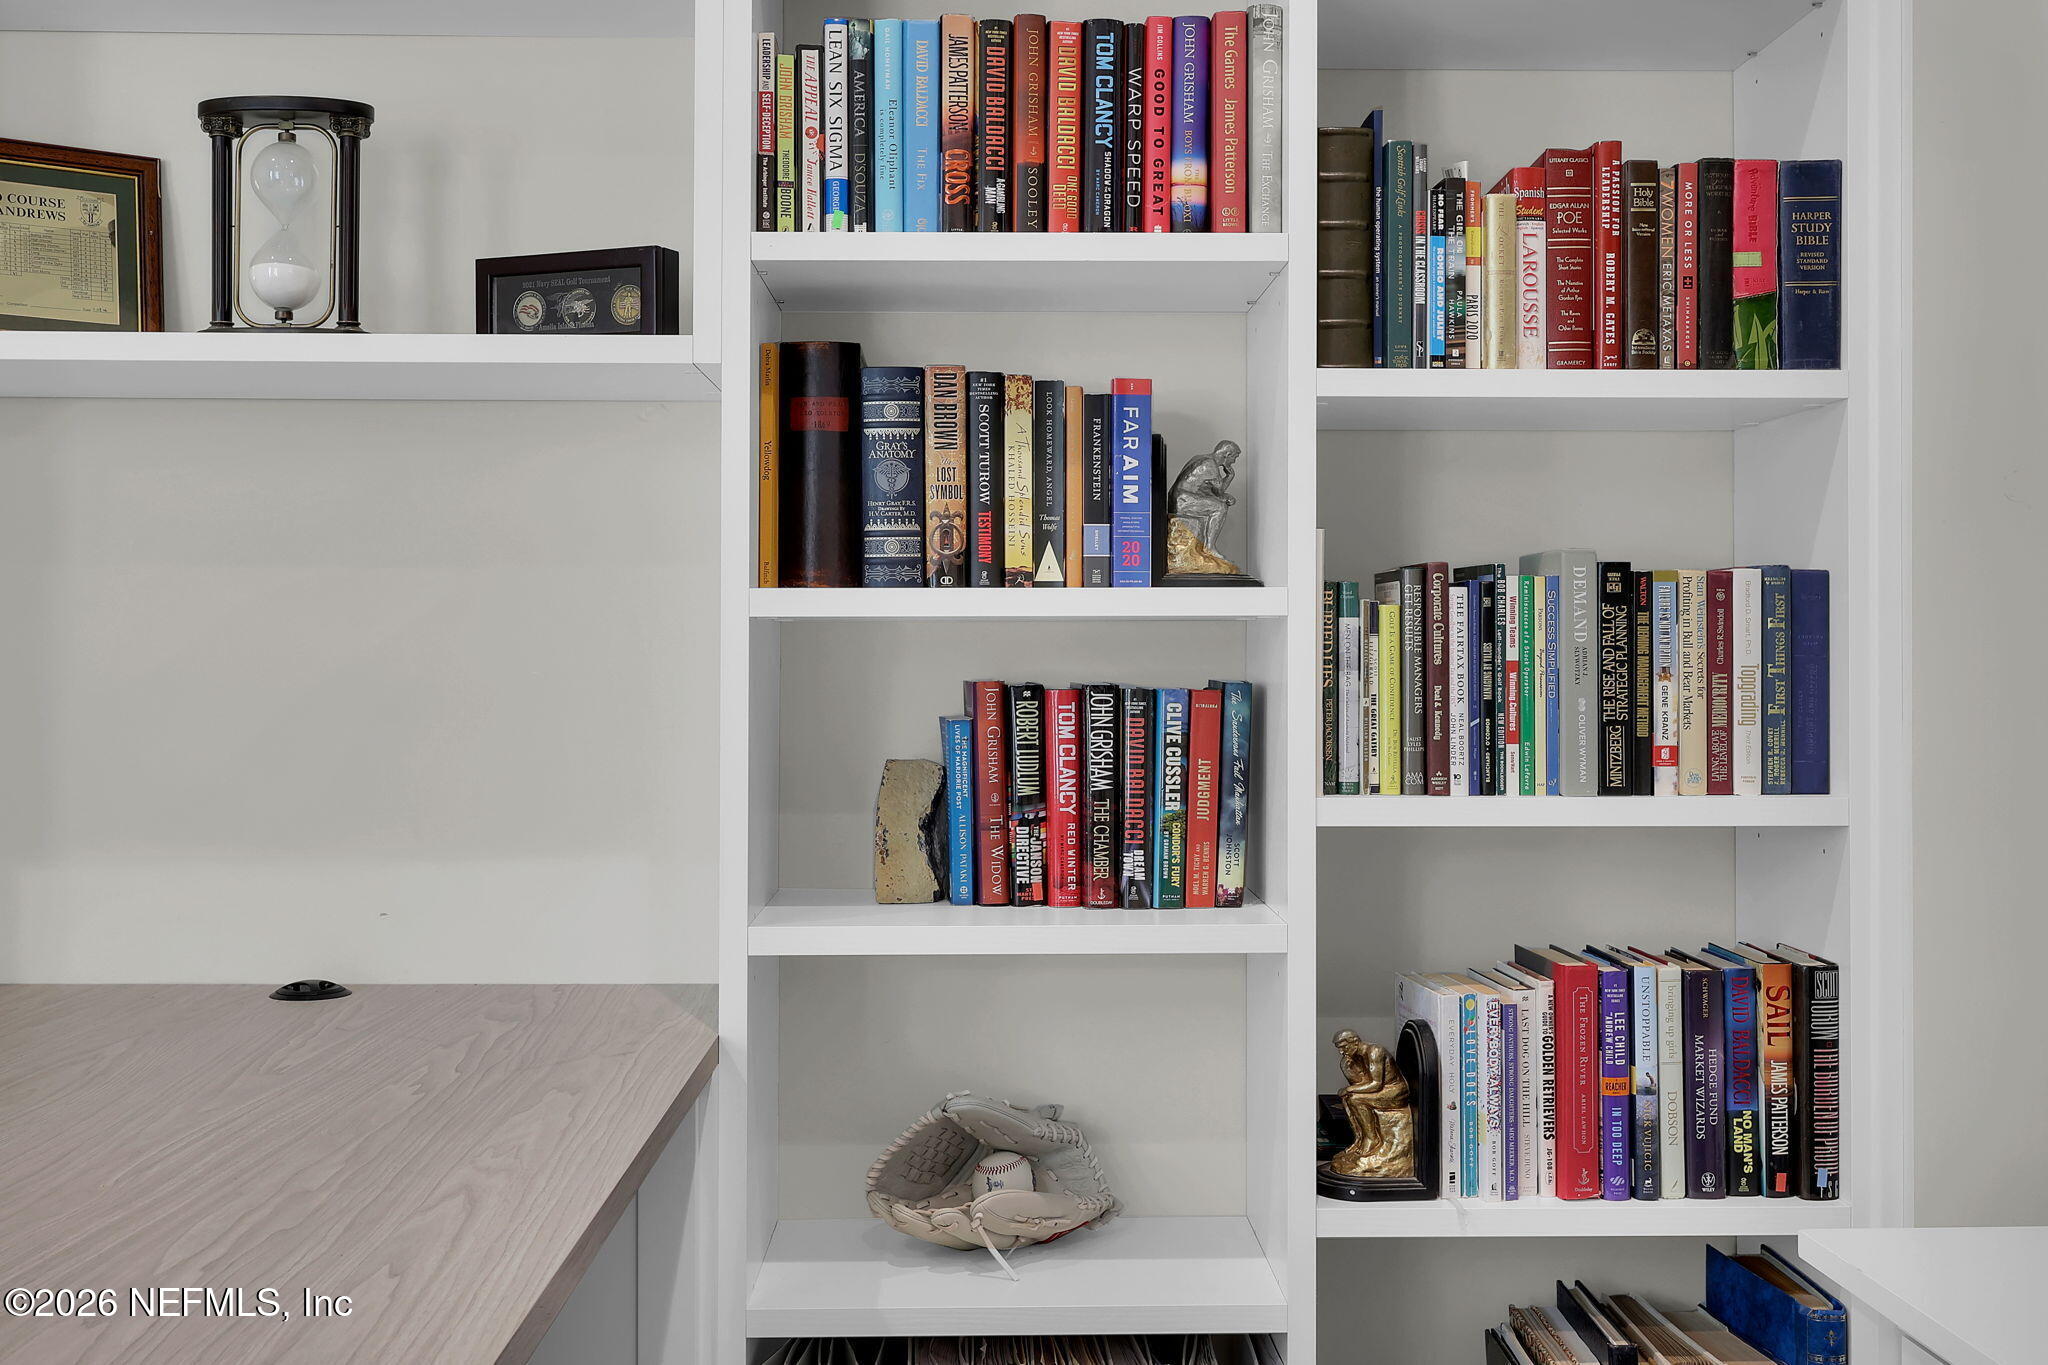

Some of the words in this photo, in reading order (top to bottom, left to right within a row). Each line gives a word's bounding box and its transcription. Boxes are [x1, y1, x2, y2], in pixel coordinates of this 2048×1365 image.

[828, 30, 842, 78] LEAN
[1095, 32, 1114, 71] TOM
[1182, 23, 1195, 58] JOHN
[1224, 25, 1238, 46] The
[762, 38, 771, 80] LEADERSHIP
[779, 63, 792, 90] JOHN
[806, 55, 815, 71] THE
[986, 46, 1006, 92] DAVID
[1057, 46, 1077, 91] DAVID
[1224, 50, 1238, 89] Games
[804, 72, 817, 122] APPEAL
[829, 82, 842, 108] SIX
[854, 70, 865, 137] AMERICA
[1095, 75, 1114, 148] CLANCY
[1128, 67, 1142, 130] WARP
[1153, 69, 1165, 116] GOOD
[1183, 62, 1194, 124] GRISHAM
[761, 93, 772, 150] SELF-DECEPTION
[779, 95, 792, 139] GRISHAM
[888, 99, 897, 139] Eleanor
[985, 97, 1005, 171] BALDACCI
[1056, 97, 1076, 169] BALDACCI
[1224, 98, 1238, 134] James
[829, 116, 842, 171] SIGMA
[1154, 126, 1164, 148] TO
[782, 150, 790, 180] THEODORE
[805, 158, 817, 186] Janice
[854, 153, 865, 212] D'SOUZA
[886, 143, 898, 190] Oliphant
[944, 149, 970, 205] CROSS
[1127, 140, 1141, 207] SPEED
[1224, 138, 1238, 193] Patterson
[7, 194, 66, 208] COURSE
[781, 188, 792, 218] BOONE
[806, 188, 817, 219] Hallett
[1027, 168, 1038, 229] SOOLEY
[1152, 158, 1164, 215] GREAT
[1633, 198, 1654, 207] Bible
[1634, 188, 1653, 199] Holy
[1684, 182, 1693, 215] MORE
[1415, 210, 1426, 234] CRISIS
[1557, 212, 1582, 224] POE
[1684, 221, 1692, 238] OR
[1791, 223, 1833, 234] STUDY
[1792, 212, 1832, 221] HARPER
[1415, 236, 1426, 244] IN
[1415, 246, 1426, 259] THE
[1684, 242, 1692, 269] LESS
[1796, 235, 1829, 245] BIBLE
[1415, 260, 1426, 304] CLASSROOM
[1522, 233, 1539, 338] LAROUSSE
[1466, 295, 1478, 317] PARIS
[1466, 321, 1478, 340] 2020
[934, 373, 957, 398] DAN
[875, 441, 908, 450] GRAY'S
[934, 404, 957, 450] BROWN
[978, 404, 990, 448] SCOTT
[762, 441, 772, 480] Yellowdog
[868, 450, 916, 459] ANATOMY
[1093, 418, 1101, 501] FRANKENSTEIN
[930, 485, 963, 500] SYMBOL
[937, 467, 957, 482] LOST
[978, 451, 991, 504] TUROW
[978, 511, 992, 563] TESTIMONY
[1122, 541, 1140, 553] 20
[1122, 554, 1141, 566] 20
[1431, 573, 1444, 620] Corporate
[1456, 594, 1464, 617] THE
[1572, 567, 1587, 643] DEMAND
[1602, 603, 1615, 620] OF
[1413, 585, 1422, 653] RESPONSIBLE
[1603, 621, 1615, 646] FALL
[1616, 605, 1628, 660] PLANNING
[1433, 623, 1444, 665] Cultures
[1603, 648, 1615, 671] AND
[1414, 656, 1422, 714] MANAGERS
[1603, 673, 1615, 696] RISE
[1616, 663, 1629, 721] STRATEGIC
[1661, 685, 1669, 708] GENE
[1737, 663, 1759, 726] Topgrading
[1016, 700, 1039, 745] ROBERT
[1058, 702, 1075, 739] TOM
[1090, 691, 1113, 727] JOHN
[1166, 702, 1182, 744] CLIVE
[1603, 698, 1616, 722] THE
[1578, 714, 1586, 745] OLIVER
[1017, 750, 1040, 796] LUDLUM
[1090, 730, 1114, 791] GRISHAM
[1579, 748, 1587, 783] WYMAN
[1609, 725, 1622, 787] MINTZBERG
[1058, 744, 1076, 815] CLANCY
[1164, 747, 1181, 811] CUSSLER
[1197, 758, 1211, 821] JUDGMENT
[1093, 799, 1110, 822] THE
[1067, 823, 1075, 845] RED
[1092, 825, 1110, 881] CHAMBER
[1067, 849, 1076, 891] WINTER
[1224, 834, 1233, 876] JOHNSTON
[1641, 976, 1651, 1062] UNSTOPPABLE
[1731, 976, 1751, 1023] DAVID
[1765, 985, 1791, 1047] SAIL
[1521, 1009, 1529, 1034] LAST
[1614, 1012, 1625, 1033] LEE
[1466, 1030, 1476, 1064] LOVE
[1542, 1035, 1553, 1076] GOLDEN
[1615, 1036, 1625, 1065] CHILD
[1694, 1035, 1704, 1084] MARKET
[1522, 1062, 1530, 1075] ON
[1708, 1049, 1717, 1089] HEDGE
[1732, 1030, 1751, 1105] BALDACCI
[1770, 1060, 1788, 1094] JAMES
[1466, 1073, 1476, 1106] DOES
[1522, 1078, 1530, 1099] THE
[1522, 1104, 1531, 1128] HILL
[1542, 1080, 1555, 1140] RETRIEVERS
[1611, 1107, 1621, 1117] IN
[1667, 1091, 1678, 1146] DOBSON
[1695, 1087, 1705, 1140] WIZARDS
[1709, 1092, 1718, 1125] FUND
[1742, 1110, 1753, 1130] NO
[1771, 1096, 1788, 1156] PATTERSON
[1612, 1120, 1622, 1138] TOO
[1733, 1118, 1743, 1153] LAND
[1612, 1141, 1622, 1166] DEEP
[1743, 1133, 1753, 1173] MAN'S
